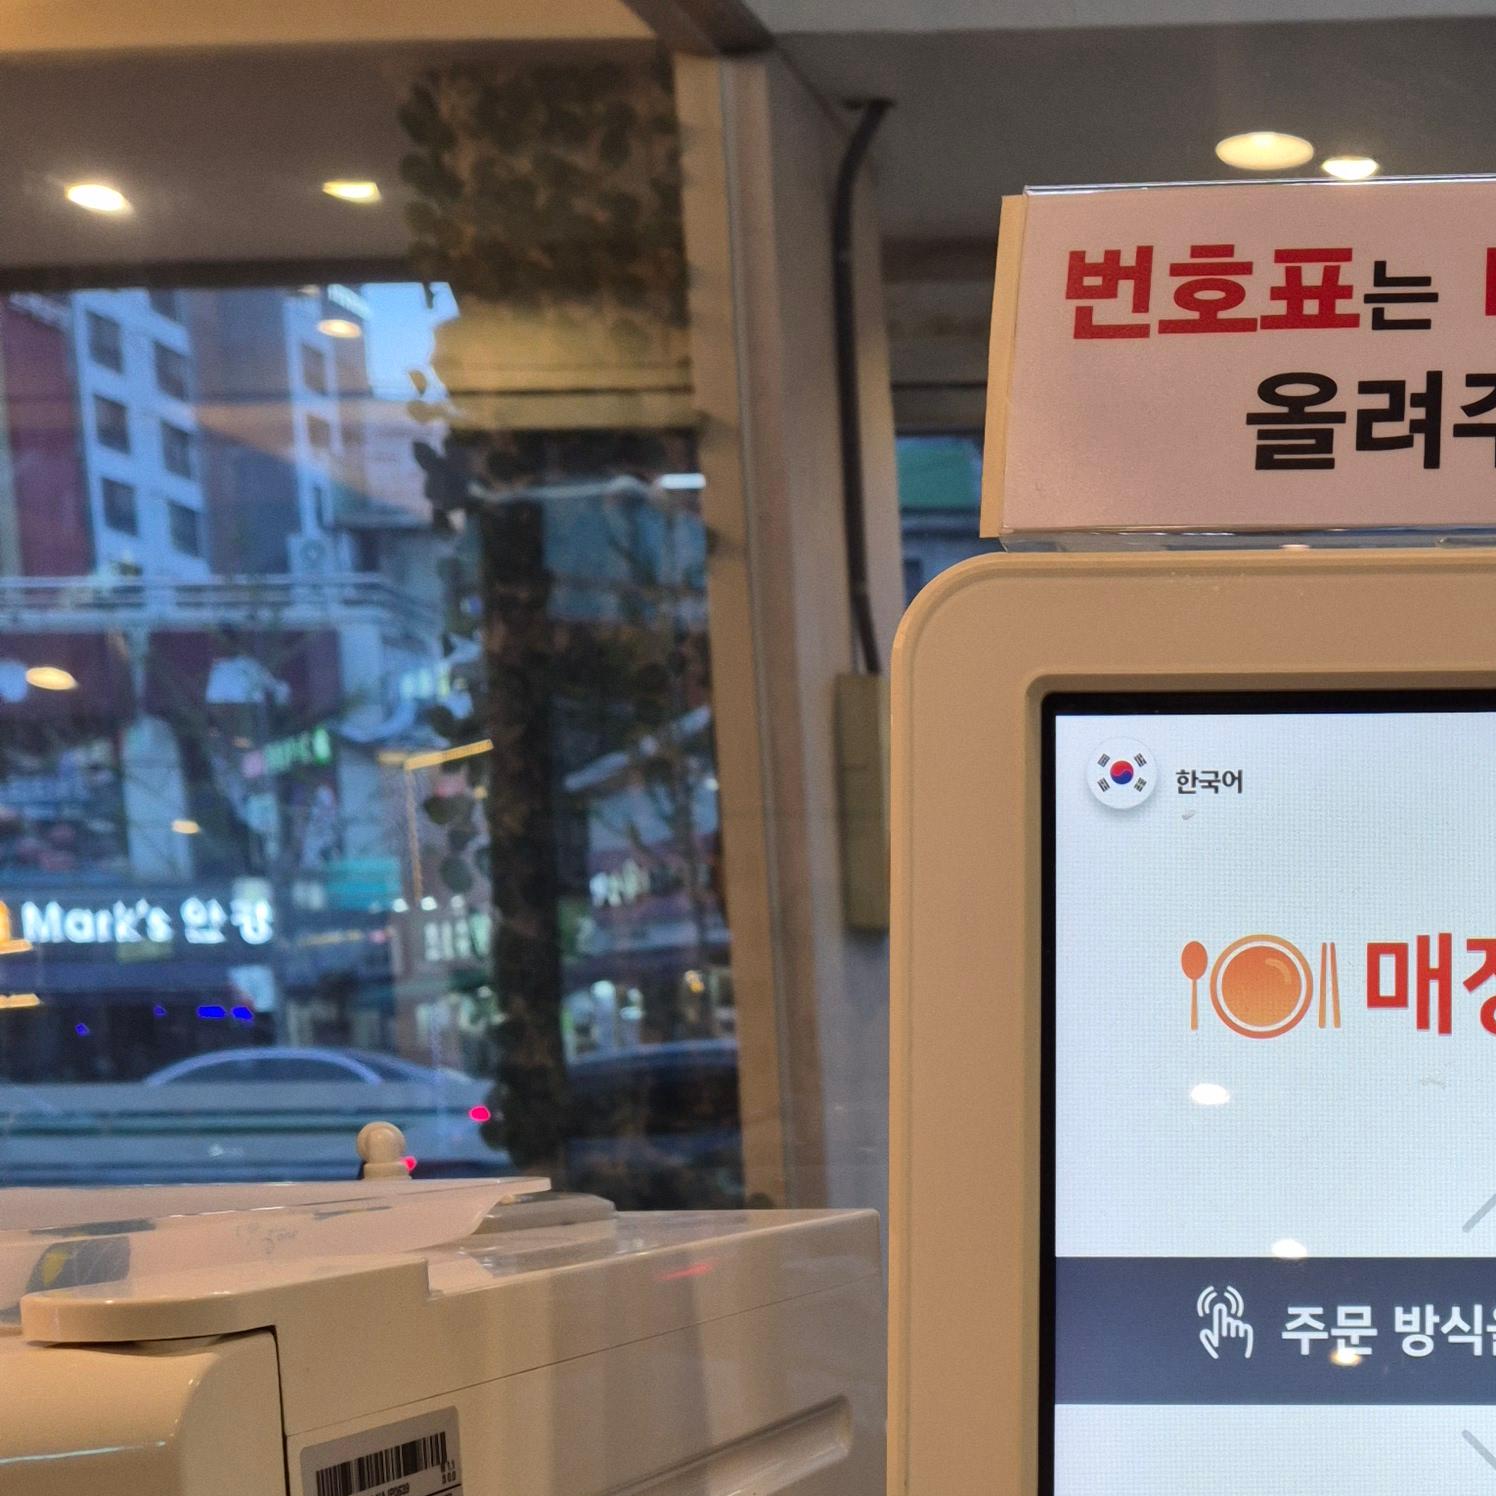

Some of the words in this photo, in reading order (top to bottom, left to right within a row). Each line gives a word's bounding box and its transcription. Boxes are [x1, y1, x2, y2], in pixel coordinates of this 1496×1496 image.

[1065, 243, 1440, 340] 번호표는
[1175, 768, 1244, 796] 한국어
[20, 898, 174, 943] Mark's
[1280, 1305, 1379, 1357] 주문
